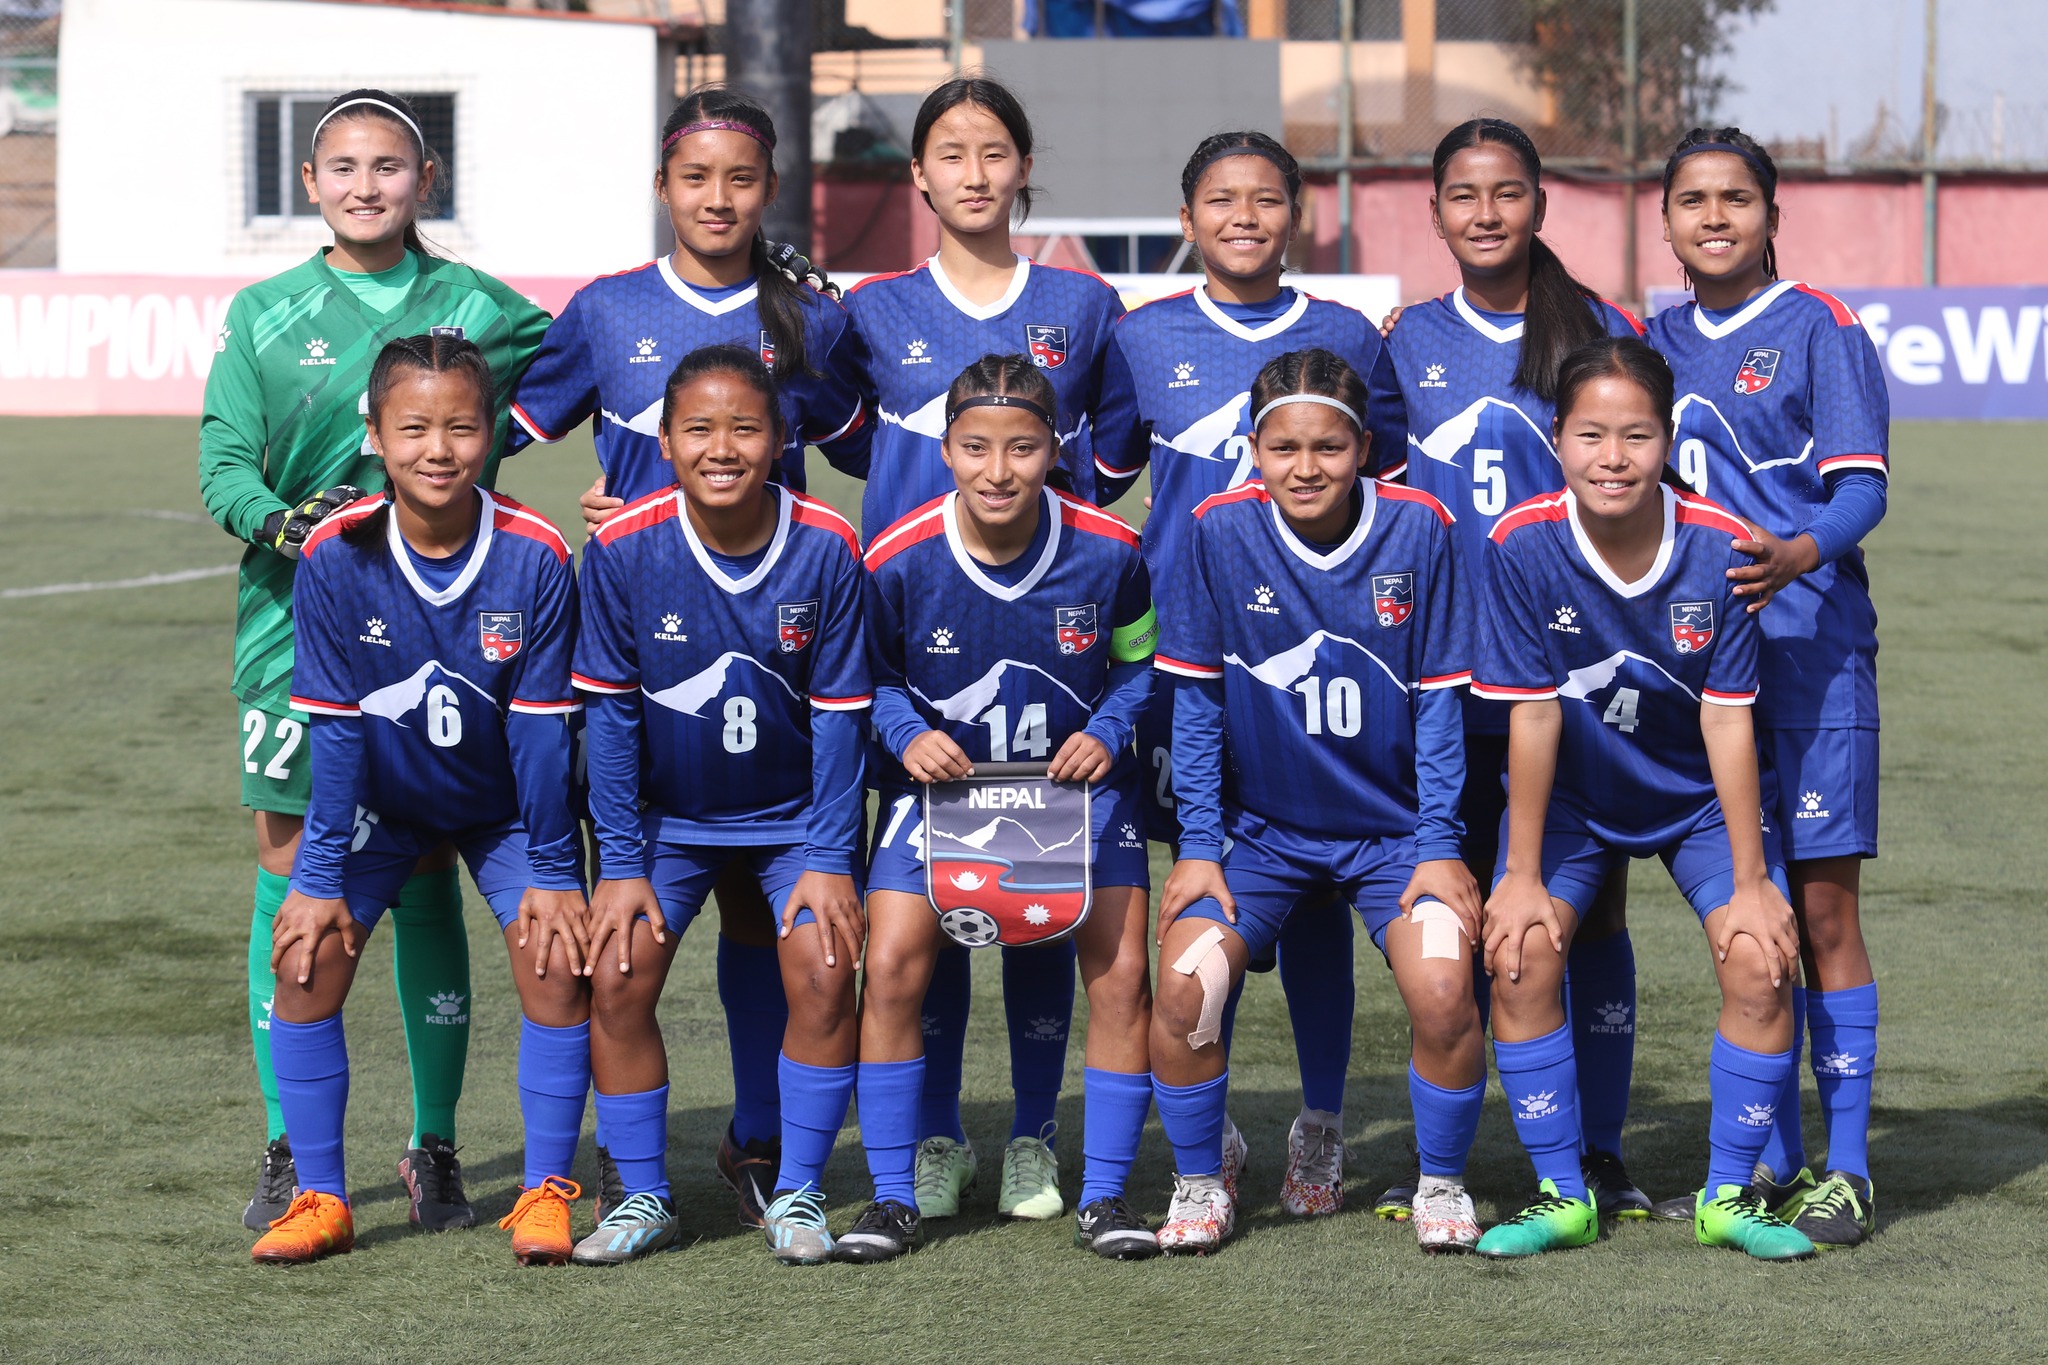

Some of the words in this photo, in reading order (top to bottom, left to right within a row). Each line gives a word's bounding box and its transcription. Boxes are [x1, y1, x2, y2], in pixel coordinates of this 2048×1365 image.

[440, 328, 456, 336] NEPAL
[299, 357, 337, 366] KELME
[629, 355, 662, 364] KELME
[901, 356, 932, 365] KELME
[1168, 379, 1200, 389] KELME
[1419, 380, 1447, 388] KELME
[1678, 438, 1708, 498] 9
[1473, 449, 1507, 516] 5
[1383, 577, 1403, 586] NEPAL
[790, 606, 809, 614] NEPAL
[1067, 608, 1087, 618] NEPAL
[1246, 603, 1280, 615] KELME
[1681, 605, 1702, 614] NEPAL
[491, 615, 511, 623] NEPAL
[1548, 622, 1581, 635] KELME
[359, 634, 392, 648] KELME
[653, 632, 687, 643] KELME
[926, 646, 959, 654] KELME
[1296, 677, 1361, 737] 10
[1603, 687, 1639, 733] 4
[427, 684, 462, 747] 6
[722, 695, 757, 754] 8
[980, 702, 1051, 762] 14
[242, 708, 303, 781] 22
[1152, 746, 1174, 809] 2
[968, 787, 1046, 809] NEPAL
[1796, 810, 1830, 819] KELME
[425, 1014, 468, 1025] KELME
[1590, 1023, 1632, 1034] KELME
[1024, 1032, 1065, 1041] KELME
[1815, 1065, 1858, 1076] KELME
[1518, 1104, 1559, 1120] KELME
[1737, 1115, 1773, 1127] KELME
